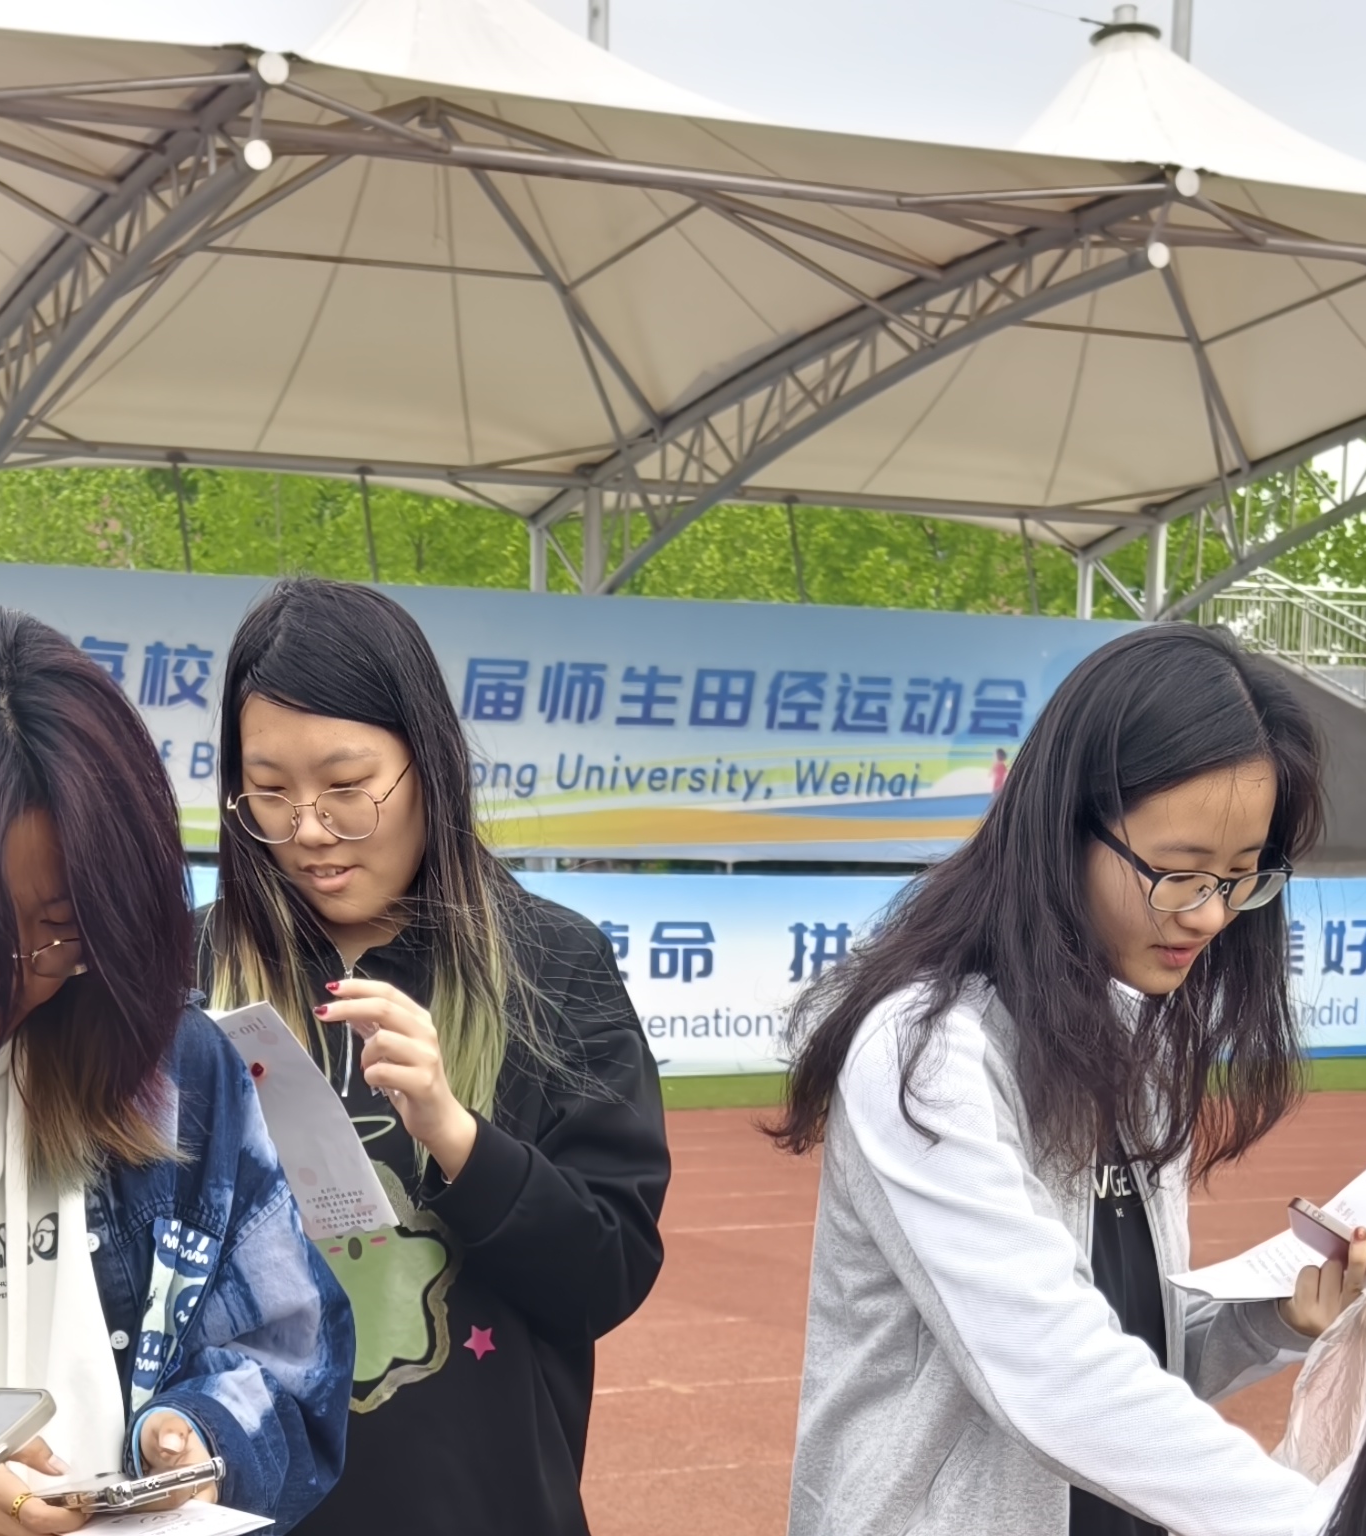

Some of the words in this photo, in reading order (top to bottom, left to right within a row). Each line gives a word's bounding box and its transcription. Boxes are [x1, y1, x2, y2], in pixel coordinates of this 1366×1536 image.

[461, 657, 1028, 738] 届师生田径运动会
[471, 761, 538, 798] ong
[556, 753, 773, 802] University,
[795, 758, 921, 798] Weihai
[788, 922, 853, 983] 拼
[1300, 998, 1358, 1026] ndid
